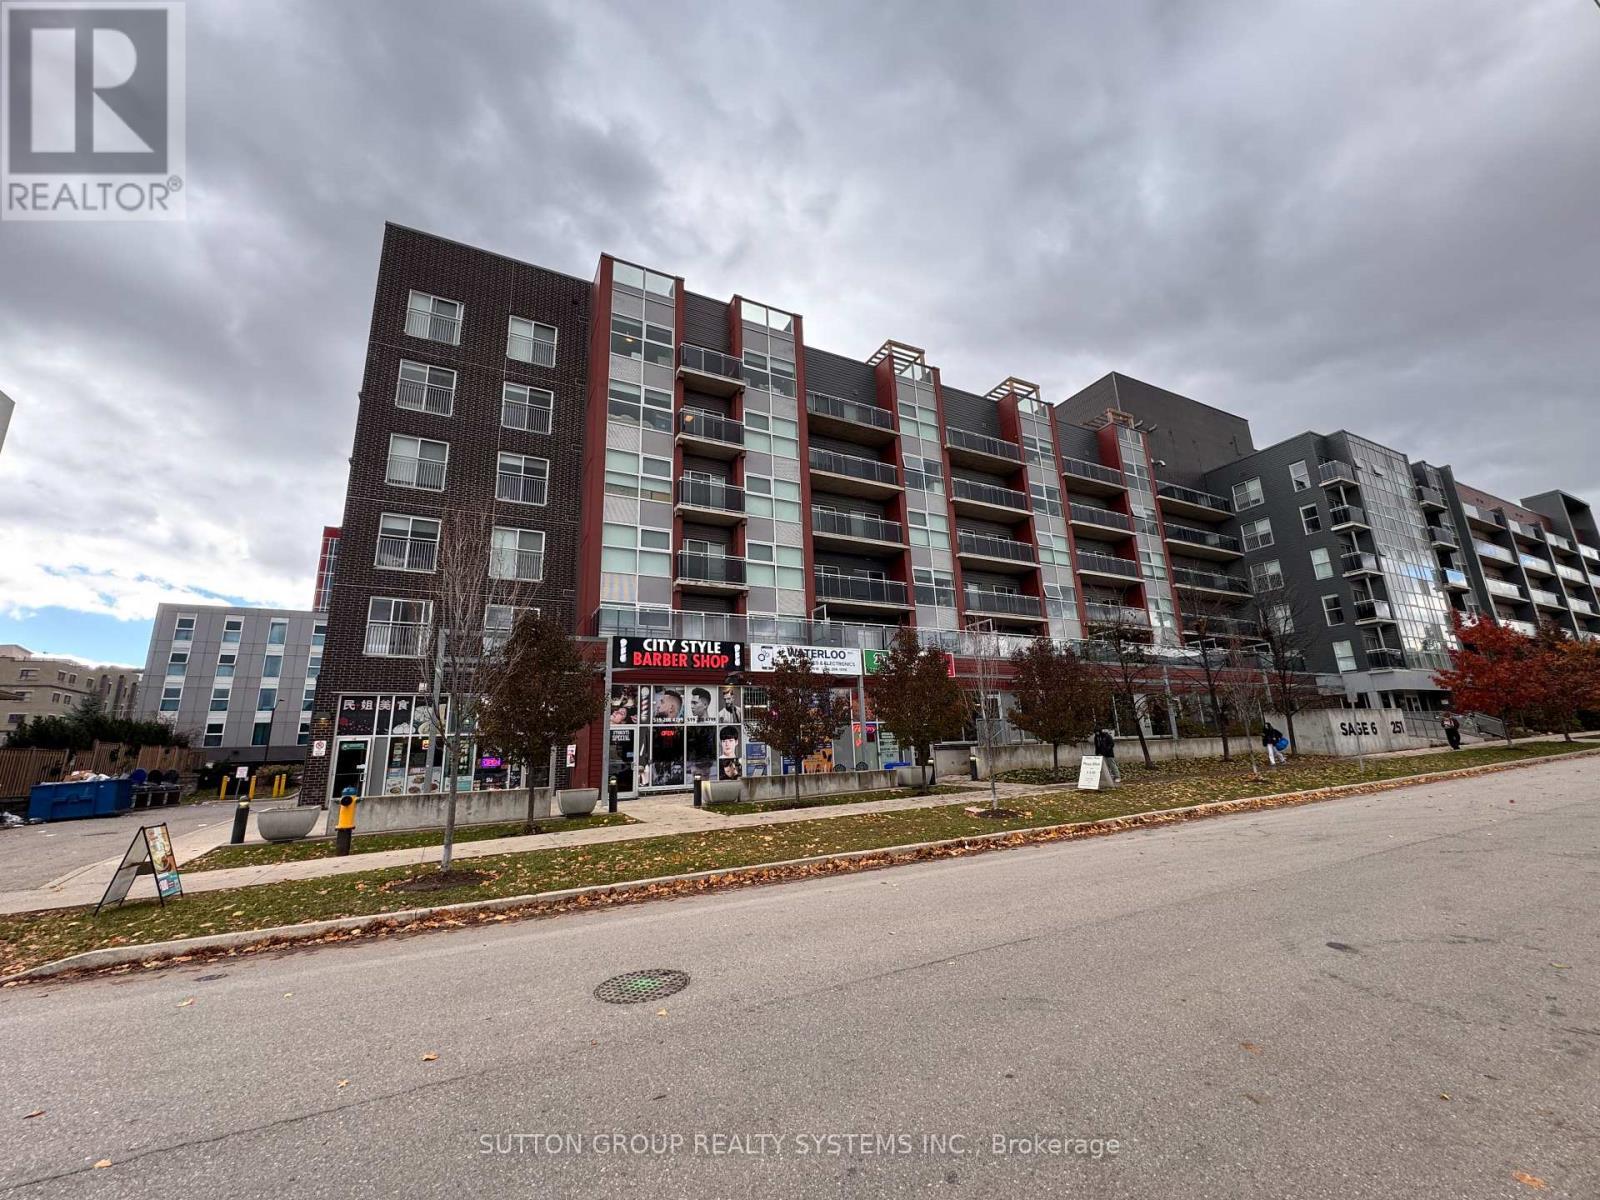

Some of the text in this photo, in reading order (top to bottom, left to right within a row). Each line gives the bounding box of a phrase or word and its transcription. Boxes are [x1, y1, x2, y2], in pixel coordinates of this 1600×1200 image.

[643, 638, 722, 654] CITY STYLE
[787, 647, 846, 660] WATERLOO
[633, 651, 729, 669] BARBER SHOP
[1340, 721, 1378, 736] SAGE 6
